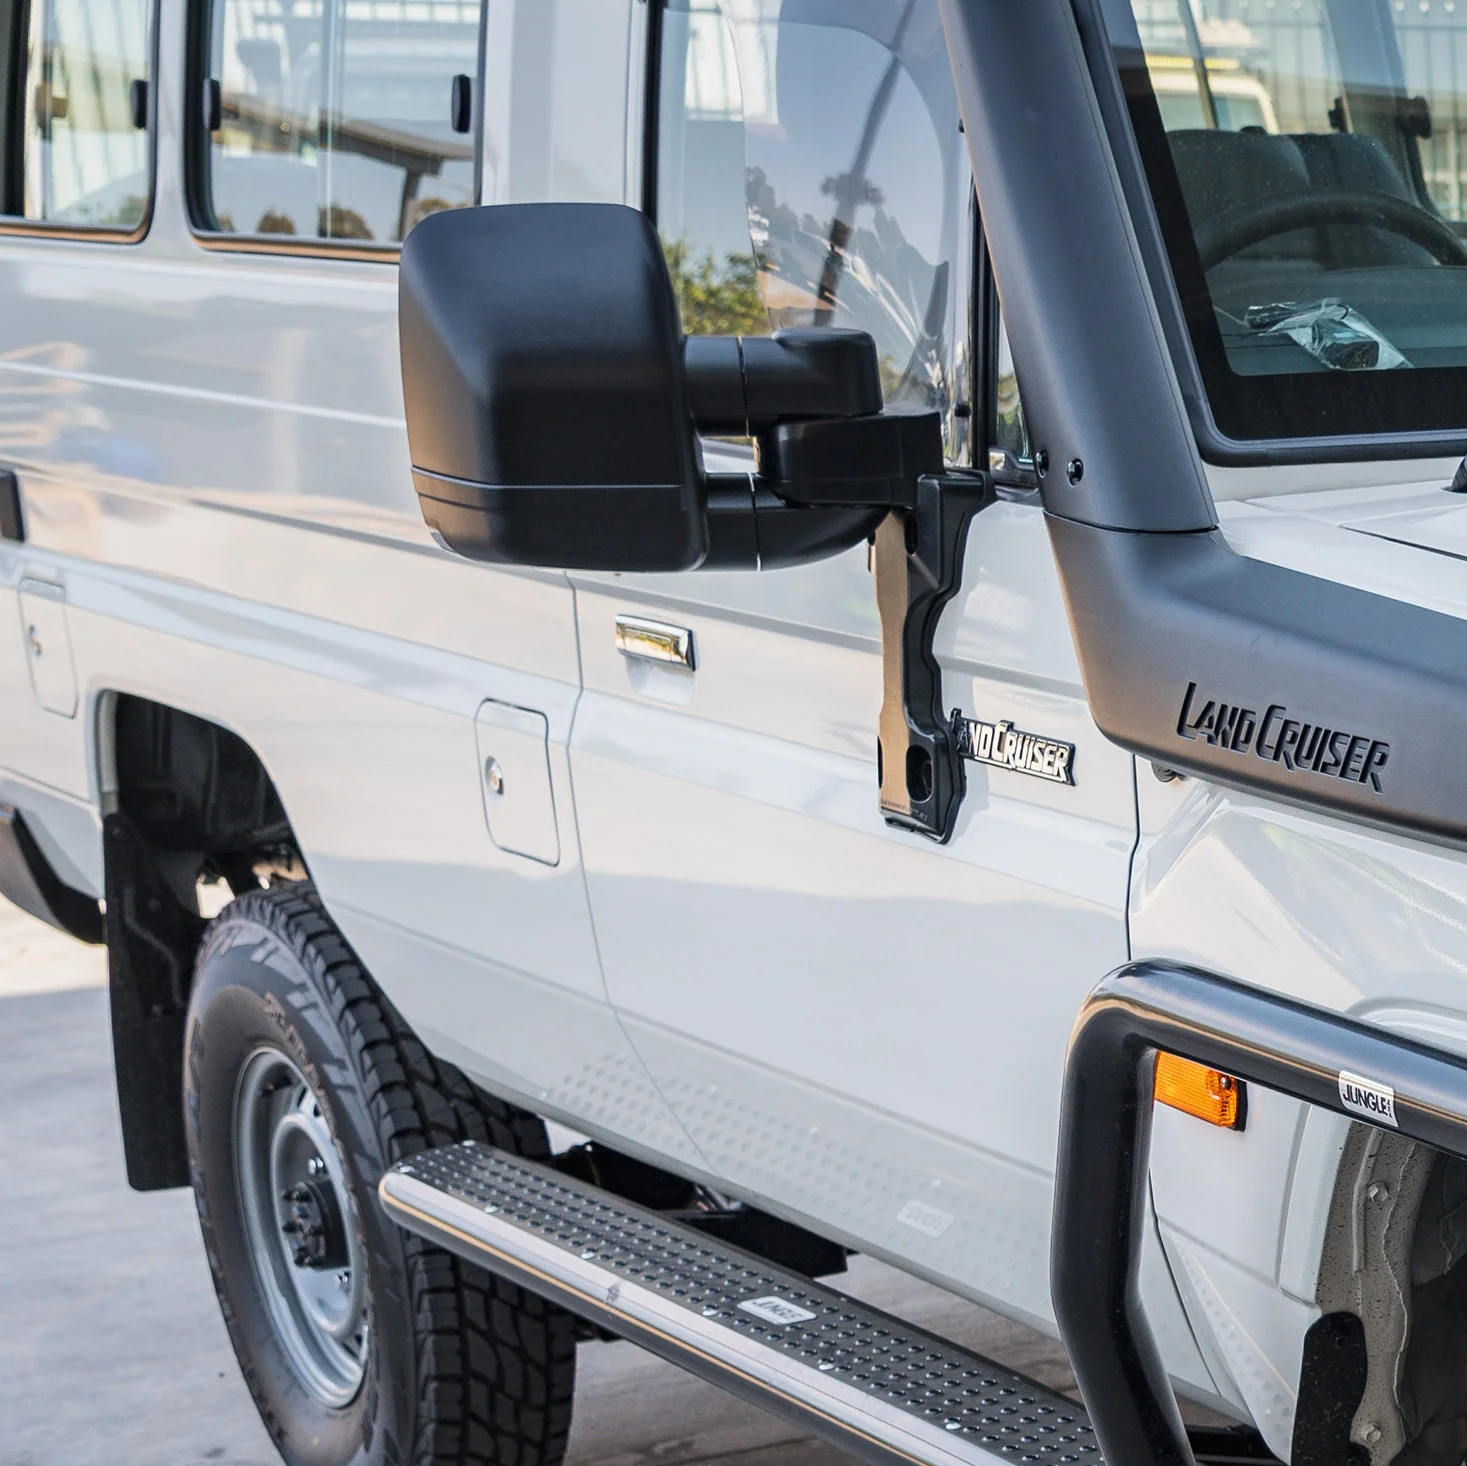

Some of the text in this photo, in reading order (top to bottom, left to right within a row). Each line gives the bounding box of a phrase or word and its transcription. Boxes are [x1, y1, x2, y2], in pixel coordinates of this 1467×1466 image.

[1176, 682, 1391, 795] LAND CRUISER
[1342, 1084, 1388, 1116] JUNGLE
